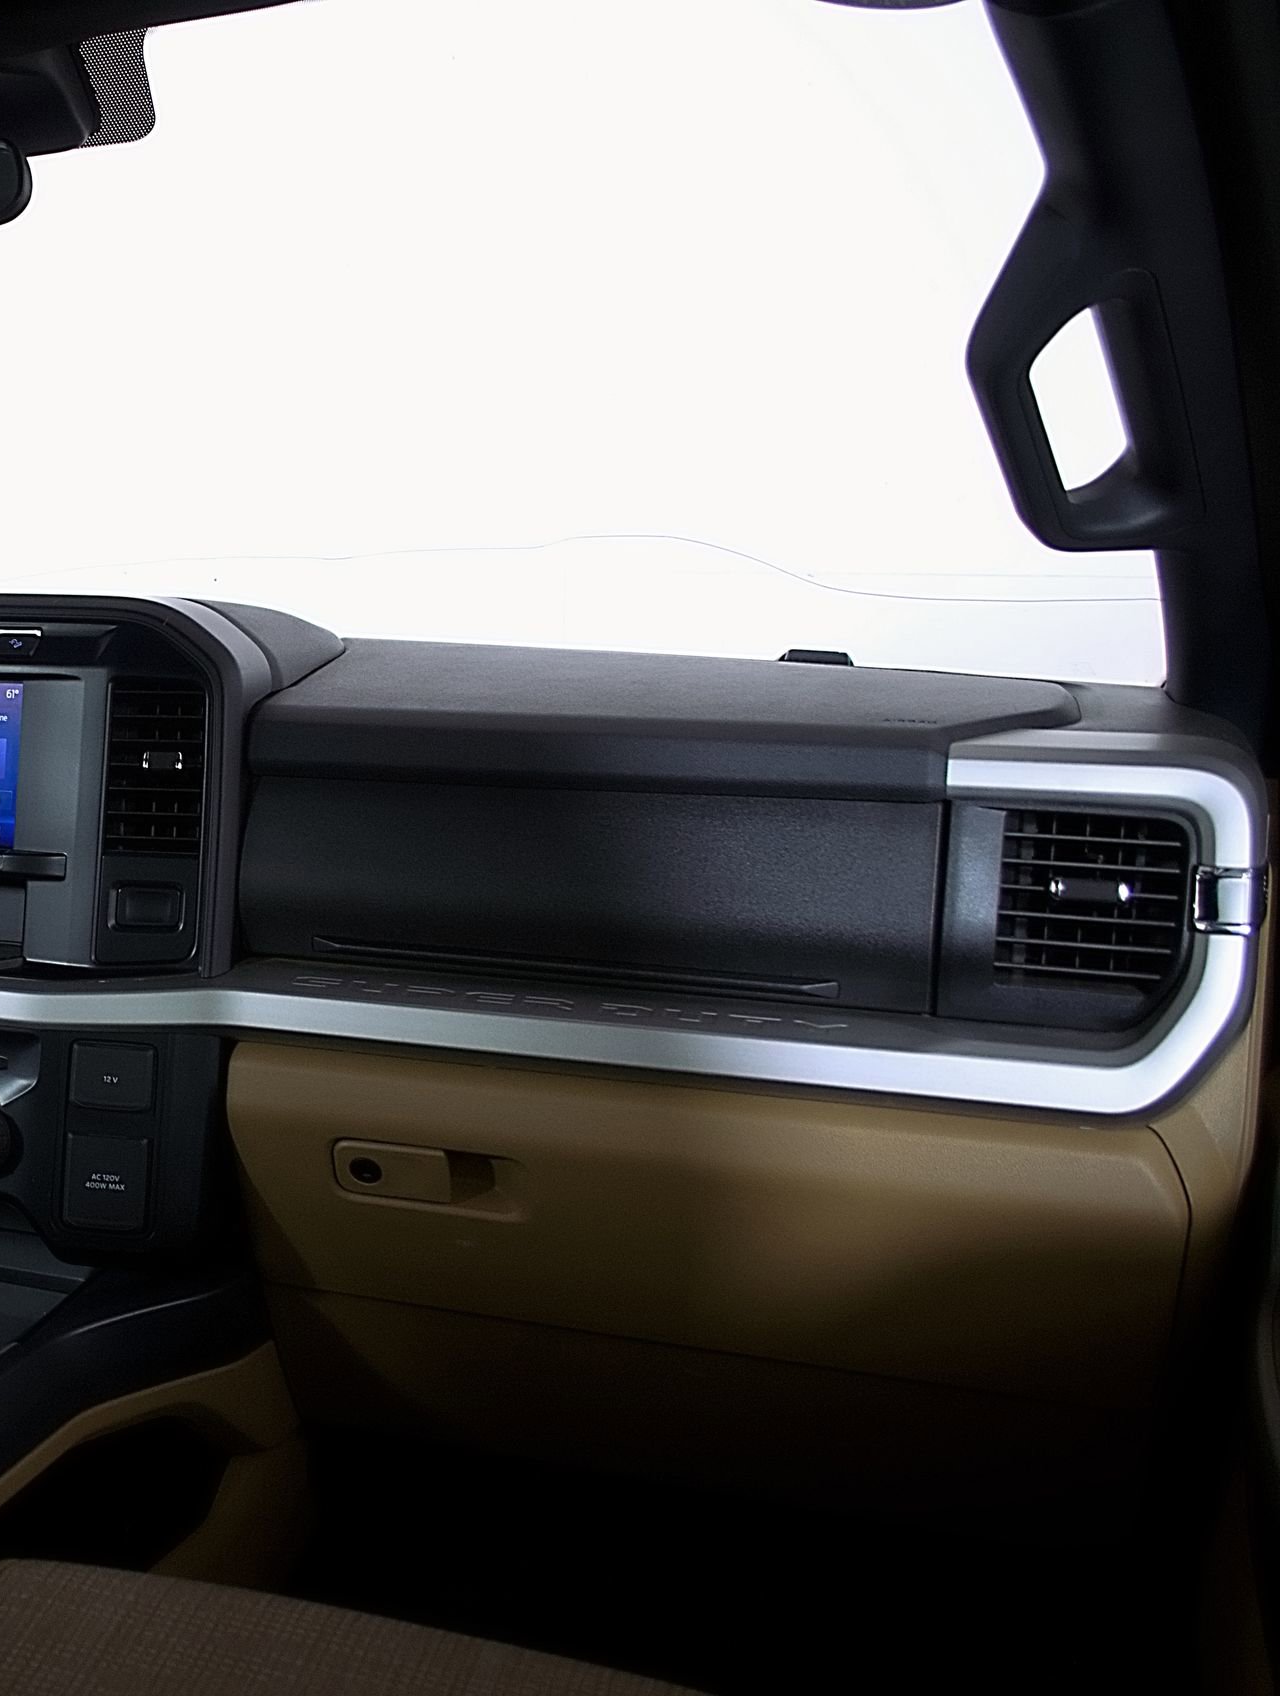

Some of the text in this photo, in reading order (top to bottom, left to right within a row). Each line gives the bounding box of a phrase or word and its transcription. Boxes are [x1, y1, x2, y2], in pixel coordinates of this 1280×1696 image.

[103, 1075, 119, 1084] 12 V
[91, 1173, 121, 1182] AC 120V
[84, 1181, 125, 1191] 400W MAX
